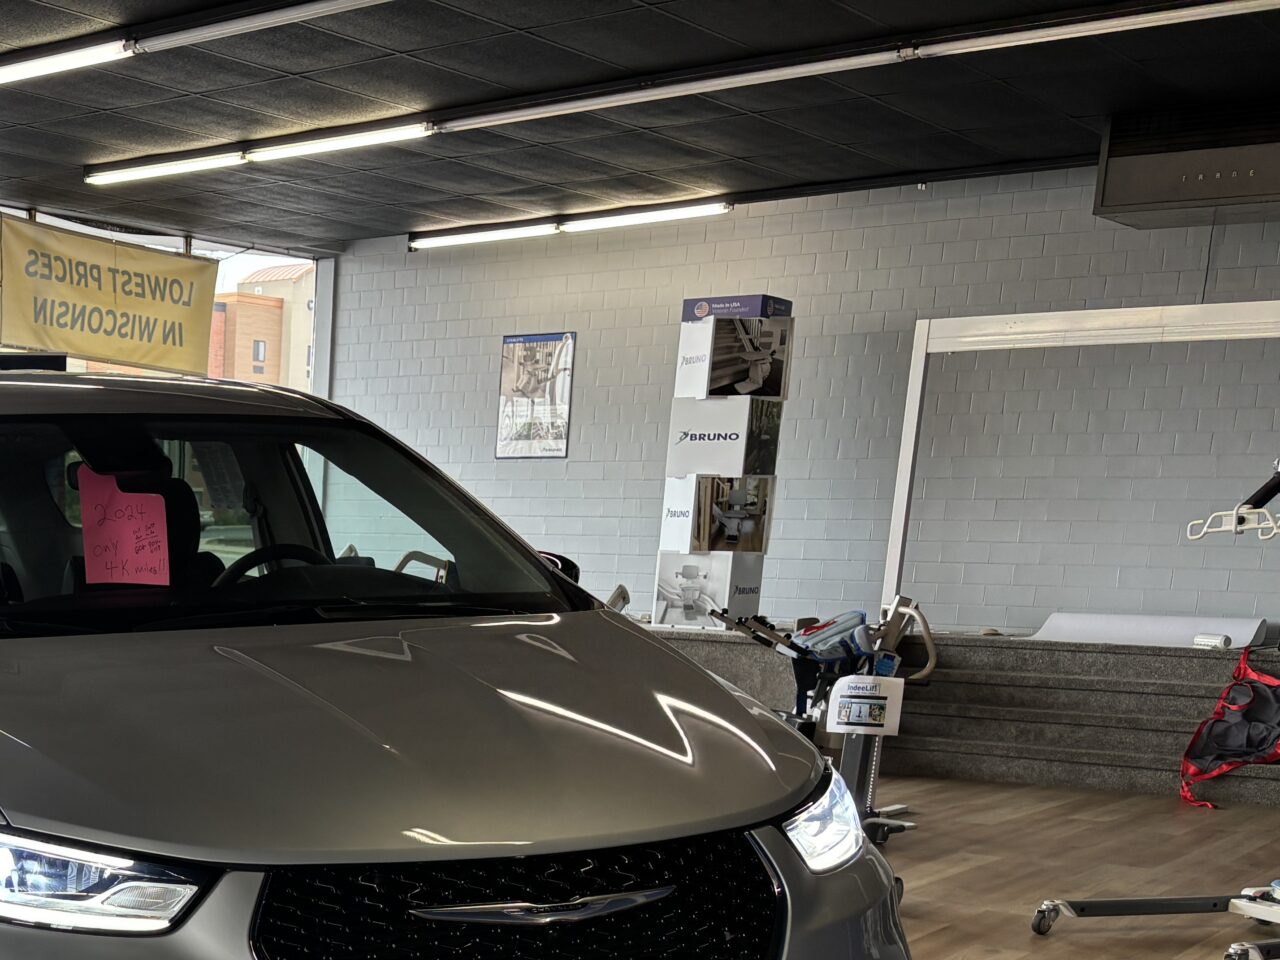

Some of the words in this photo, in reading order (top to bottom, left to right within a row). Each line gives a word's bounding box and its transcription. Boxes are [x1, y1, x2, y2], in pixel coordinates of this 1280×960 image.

[685, 354, 707, 366] BRUNO
[690, 433, 740, 441] BRUNO
[670, 510, 689, 518] BRUNO
[738, 586, 759, 595] BRUNO
